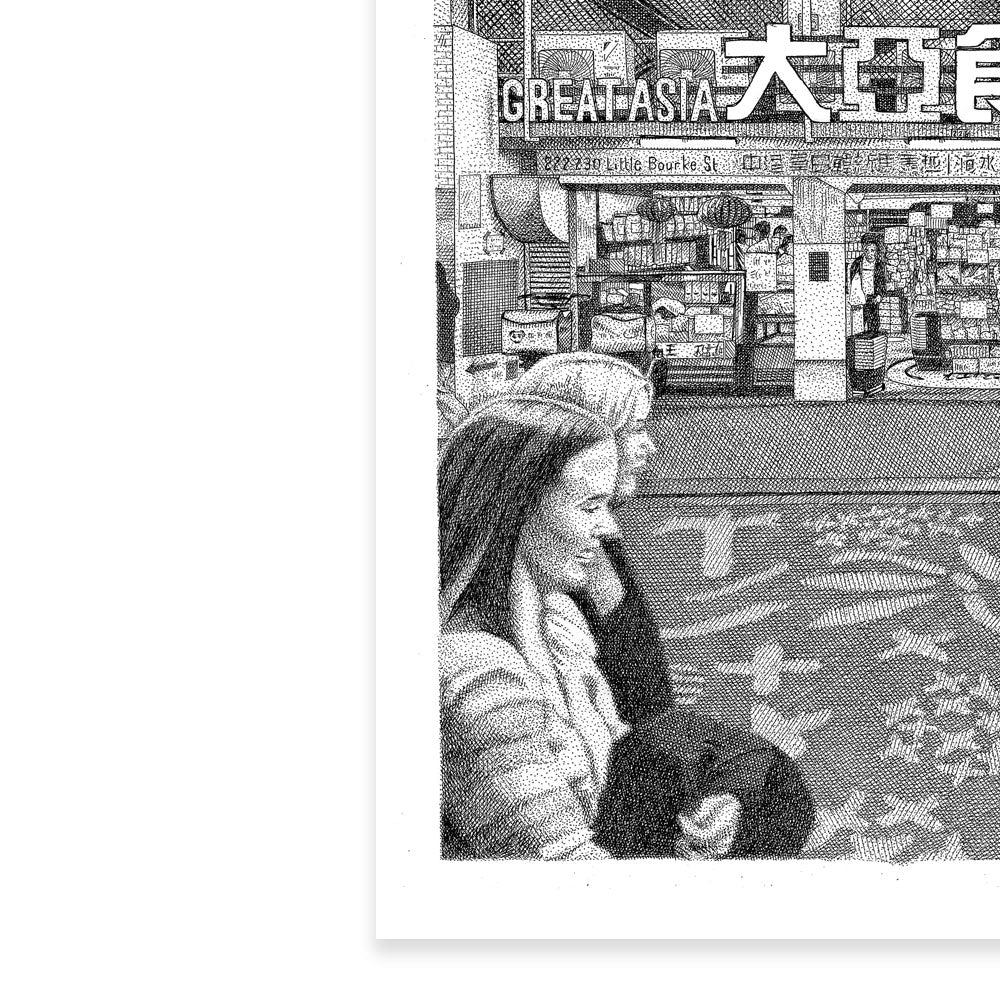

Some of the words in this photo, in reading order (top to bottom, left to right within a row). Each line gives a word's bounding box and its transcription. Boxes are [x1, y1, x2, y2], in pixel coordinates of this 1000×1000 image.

[503, 78, 621, 122] GREAT
[628, 78, 718, 122] ASIA
[607, 156, 642, 171] Little
[648, 155, 697, 171] Bourke
[704, 155, 718, 172] St
